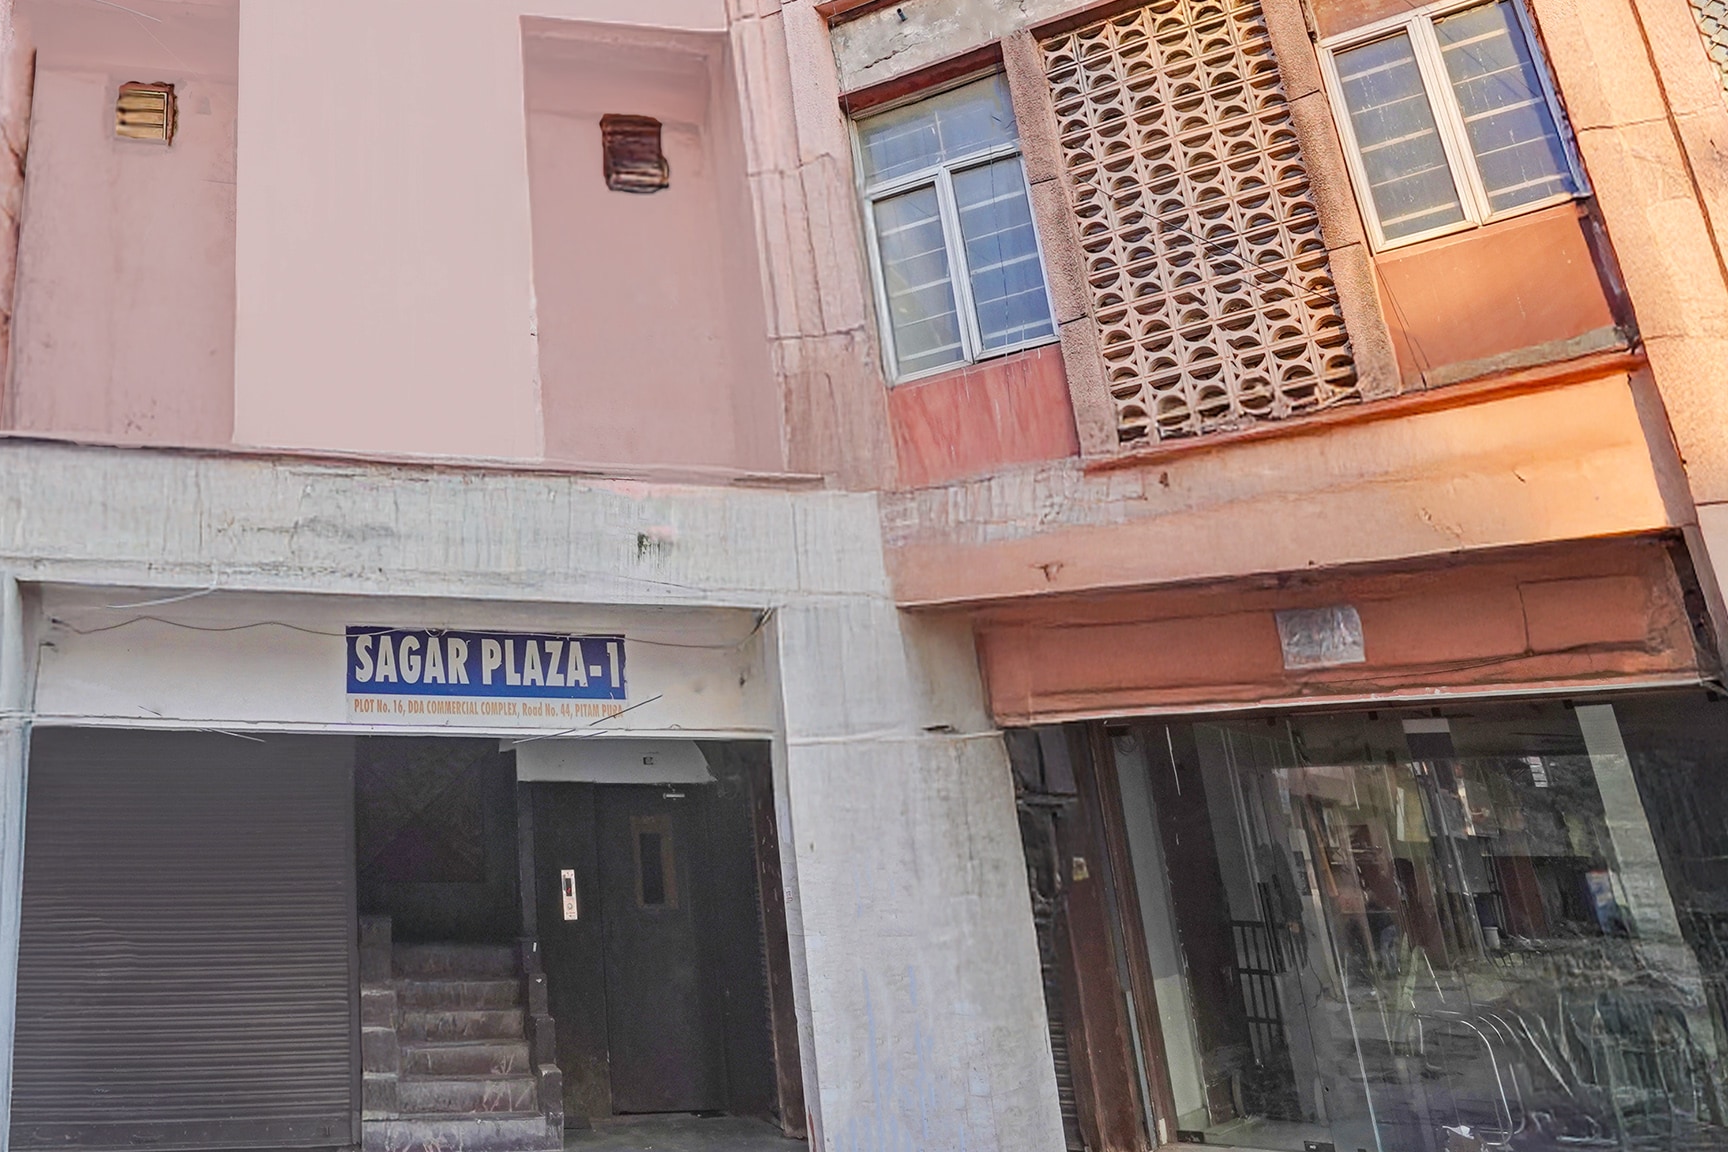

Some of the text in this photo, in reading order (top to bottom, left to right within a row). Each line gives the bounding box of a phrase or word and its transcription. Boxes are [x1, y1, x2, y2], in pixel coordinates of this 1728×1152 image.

[355, 635, 620, 688] SAGAR PLAZA-1
[354, 698, 624, 719] PLOT No. 16, DDA COMMERCIAL COMPLEX, Road No. 44, PITAM PURA
